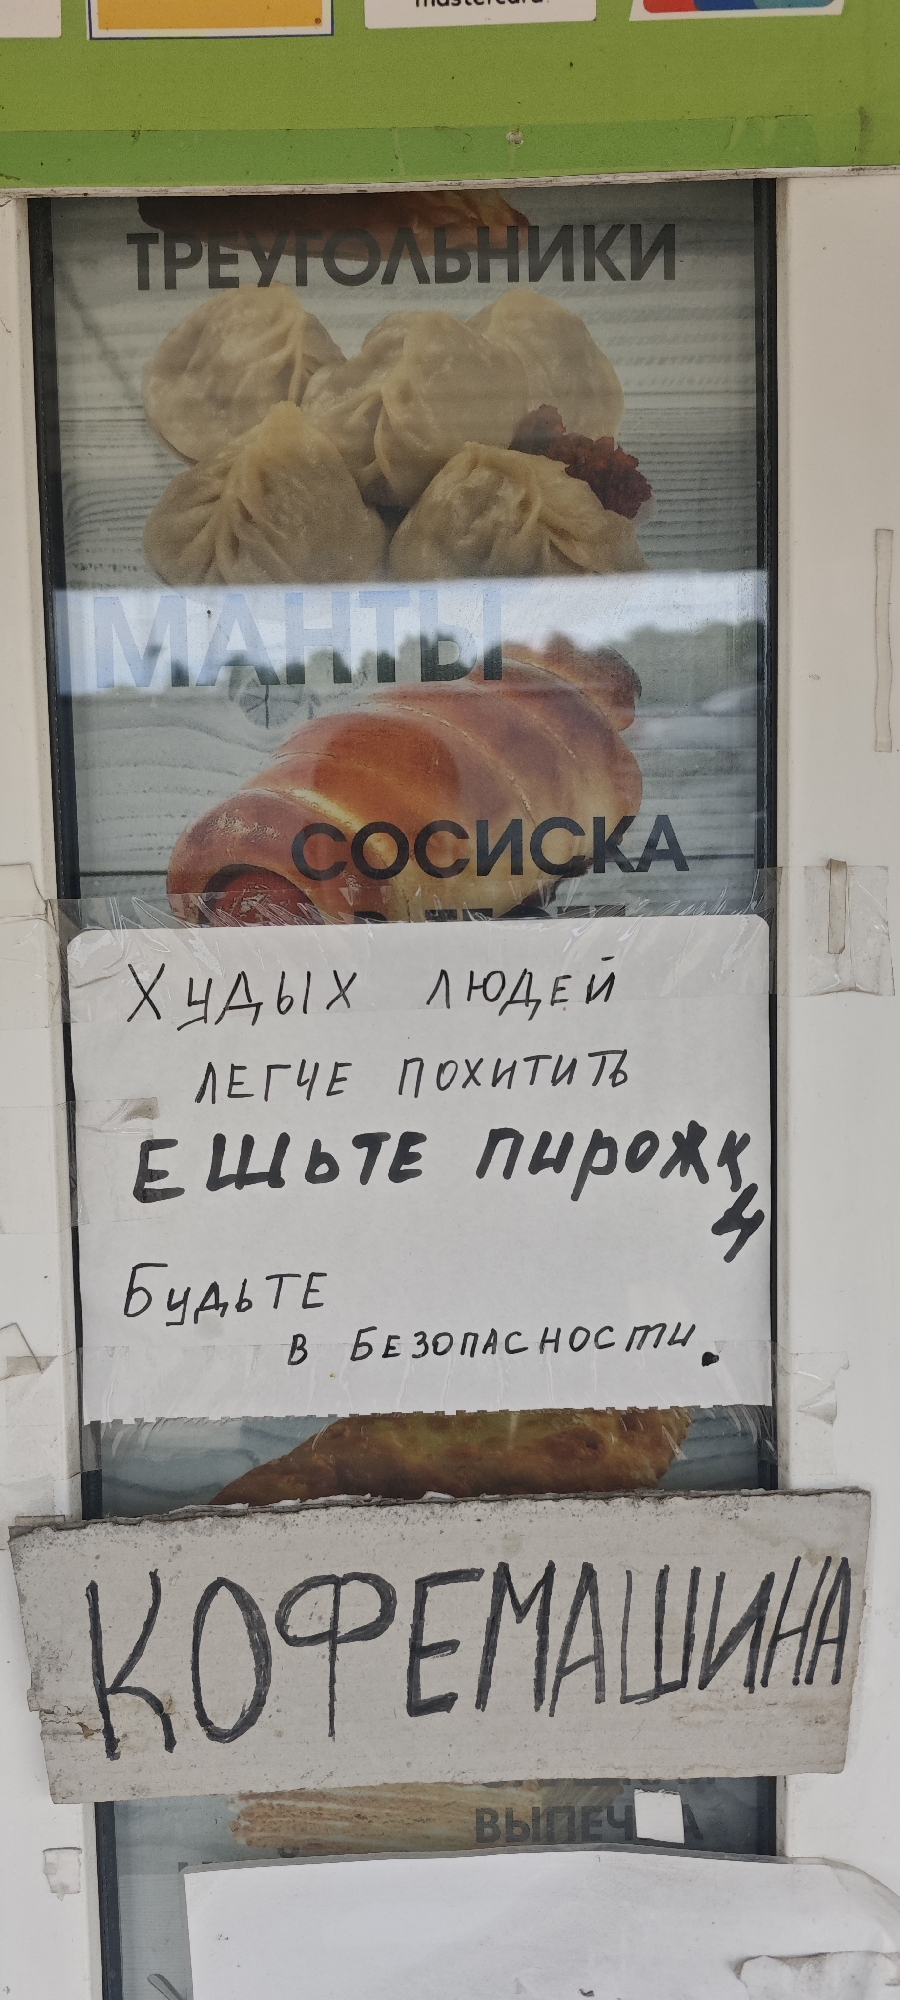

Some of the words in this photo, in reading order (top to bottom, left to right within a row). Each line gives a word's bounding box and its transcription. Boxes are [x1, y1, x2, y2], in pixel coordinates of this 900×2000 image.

[127, 223, 677, 291] ТРЕУГОЛЬНИКИ
[94, 590, 503, 688] МАНТЫ
[292, 815, 689, 880] СОСИСКА
[126, 962, 358, 1032] ХУДЫХ
[425, 956, 617, 1021] ЛЮДЕЙ
[194, 1058, 353, 1105] ЛЕГЧЕ
[398, 1048, 629, 1100] ПОХИТИТЬ
[132, 1131, 428, 1204] ЕШЬТЕ
[123, 1262, 328, 1327] БУДЬТЕ
[85, 1556, 852, 1761] КОФЕМАШИНА
[474, 1803, 704, 1844] ВЫПЕЧА
